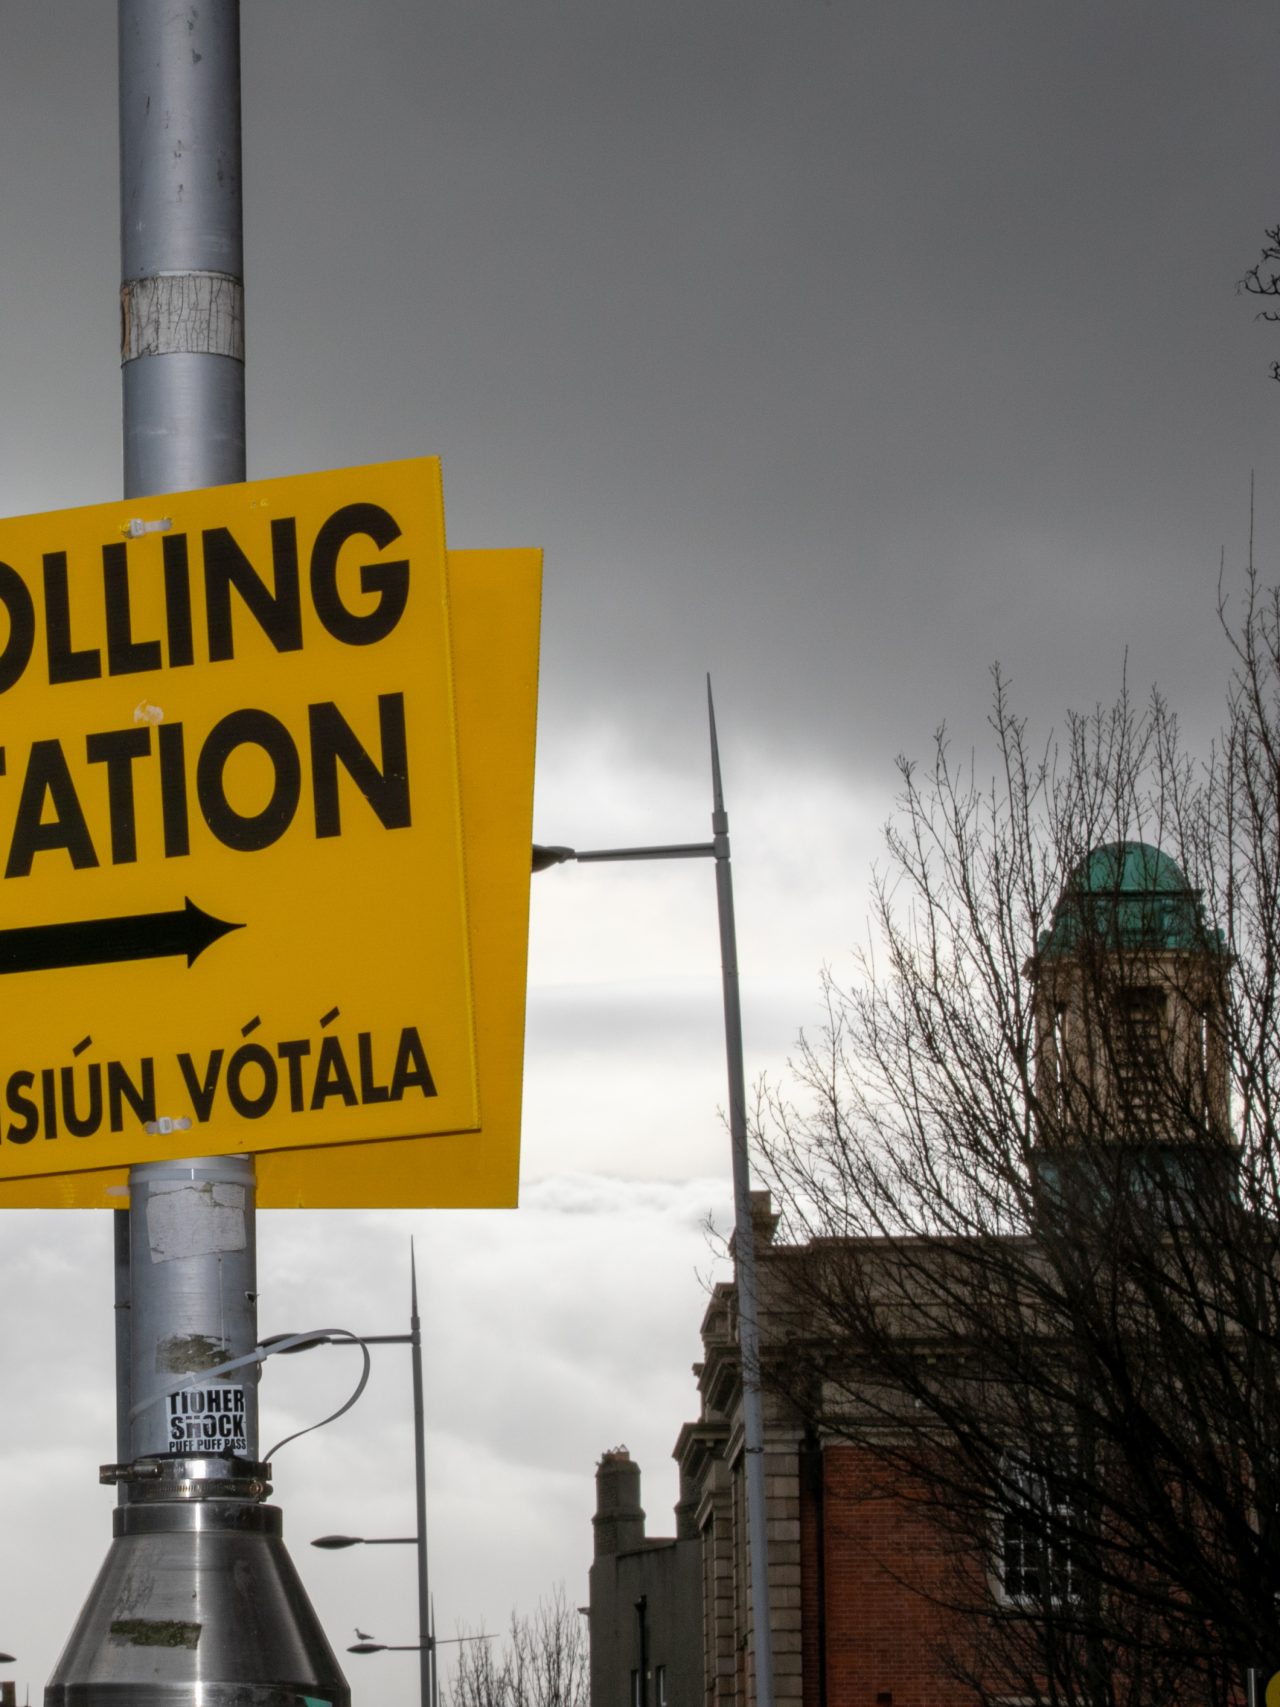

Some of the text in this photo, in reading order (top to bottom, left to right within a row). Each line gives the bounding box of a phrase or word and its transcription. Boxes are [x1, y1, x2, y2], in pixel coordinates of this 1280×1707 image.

[176, 1007, 438, 1123] VÓTÁLA
[171, 1415, 244, 1439] SHOCK
[169, 1440, 194, 1453] PUFF
[197, 1439, 222, 1450] PUFF
